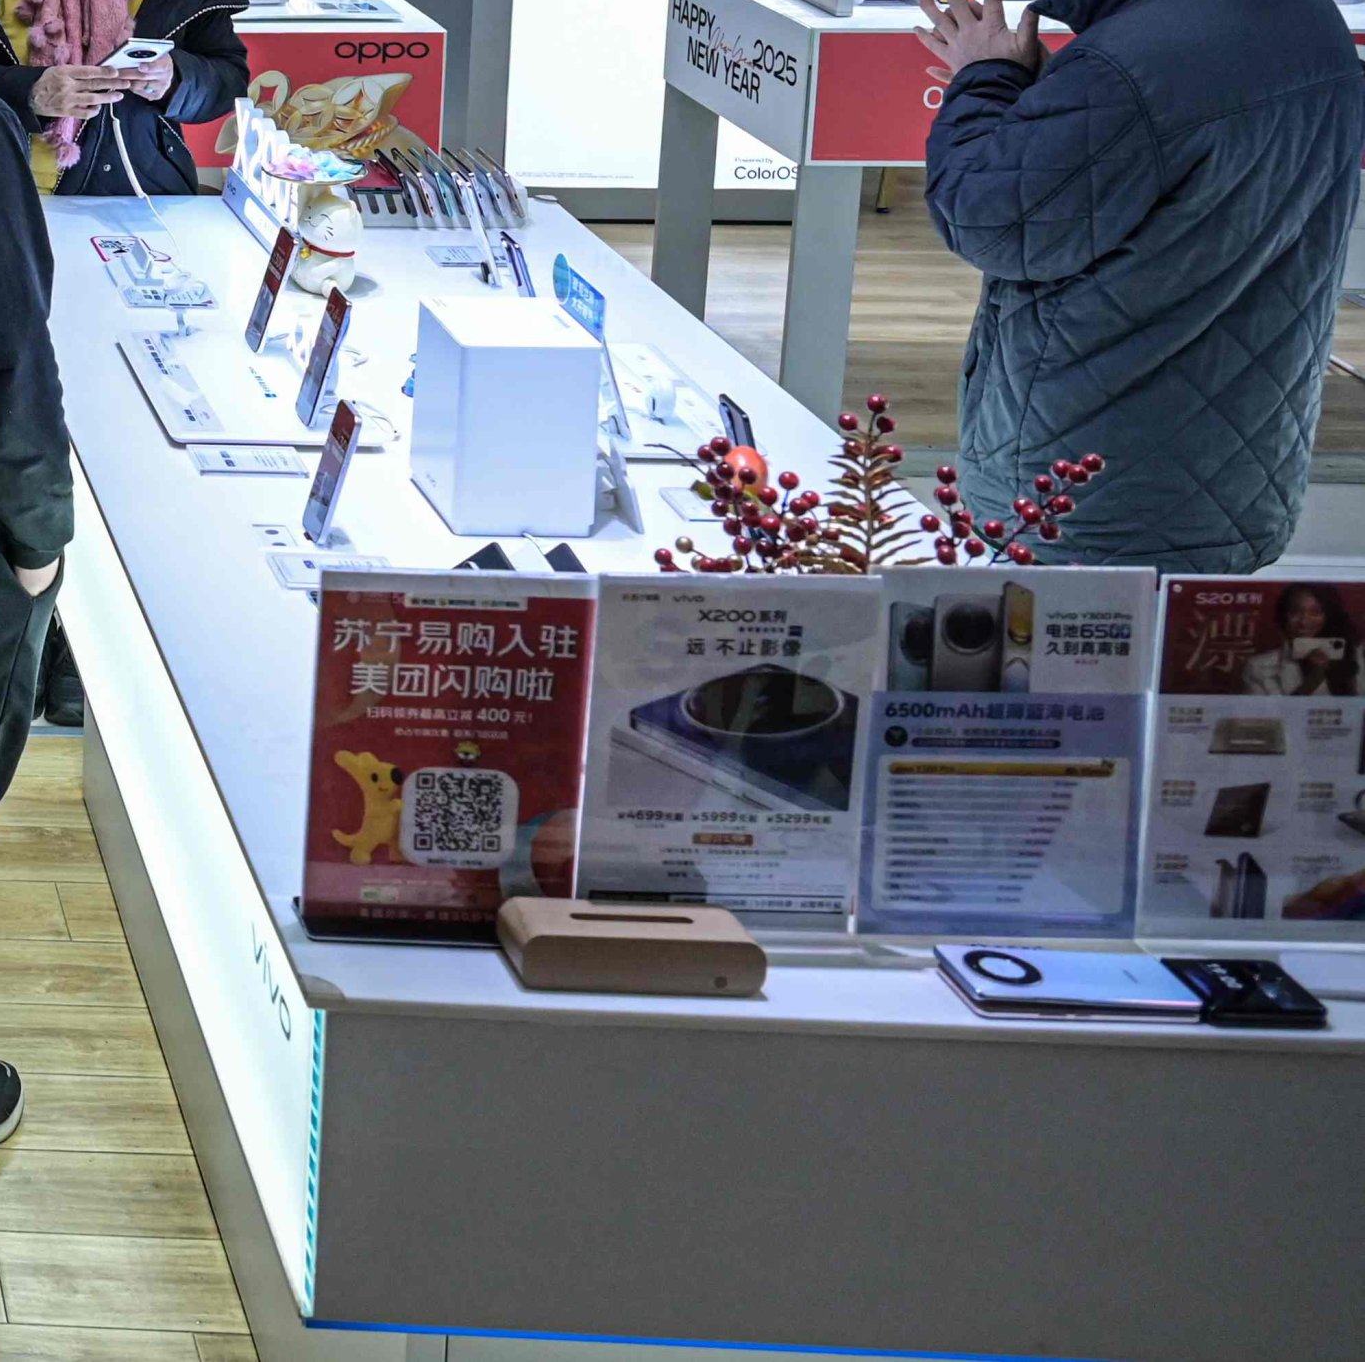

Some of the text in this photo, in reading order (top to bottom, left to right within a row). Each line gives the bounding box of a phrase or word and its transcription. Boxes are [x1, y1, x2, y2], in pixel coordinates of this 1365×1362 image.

[686, 42, 762, 104] NEW YEAR
[752, 38, 798, 87] 2025
[333, 617, 579, 662] 苏宁易购入驻
[698, 609, 788, 625] X200系列
[686, 637, 802, 657] 远 不止影像
[1186, 608, 1260, 672] 漂
[350, 662, 555, 703] 美团闪购啦
[366, 705, 511, 724] 扫码领券最高立减 400
[250, 920, 293, 1043] vivo
